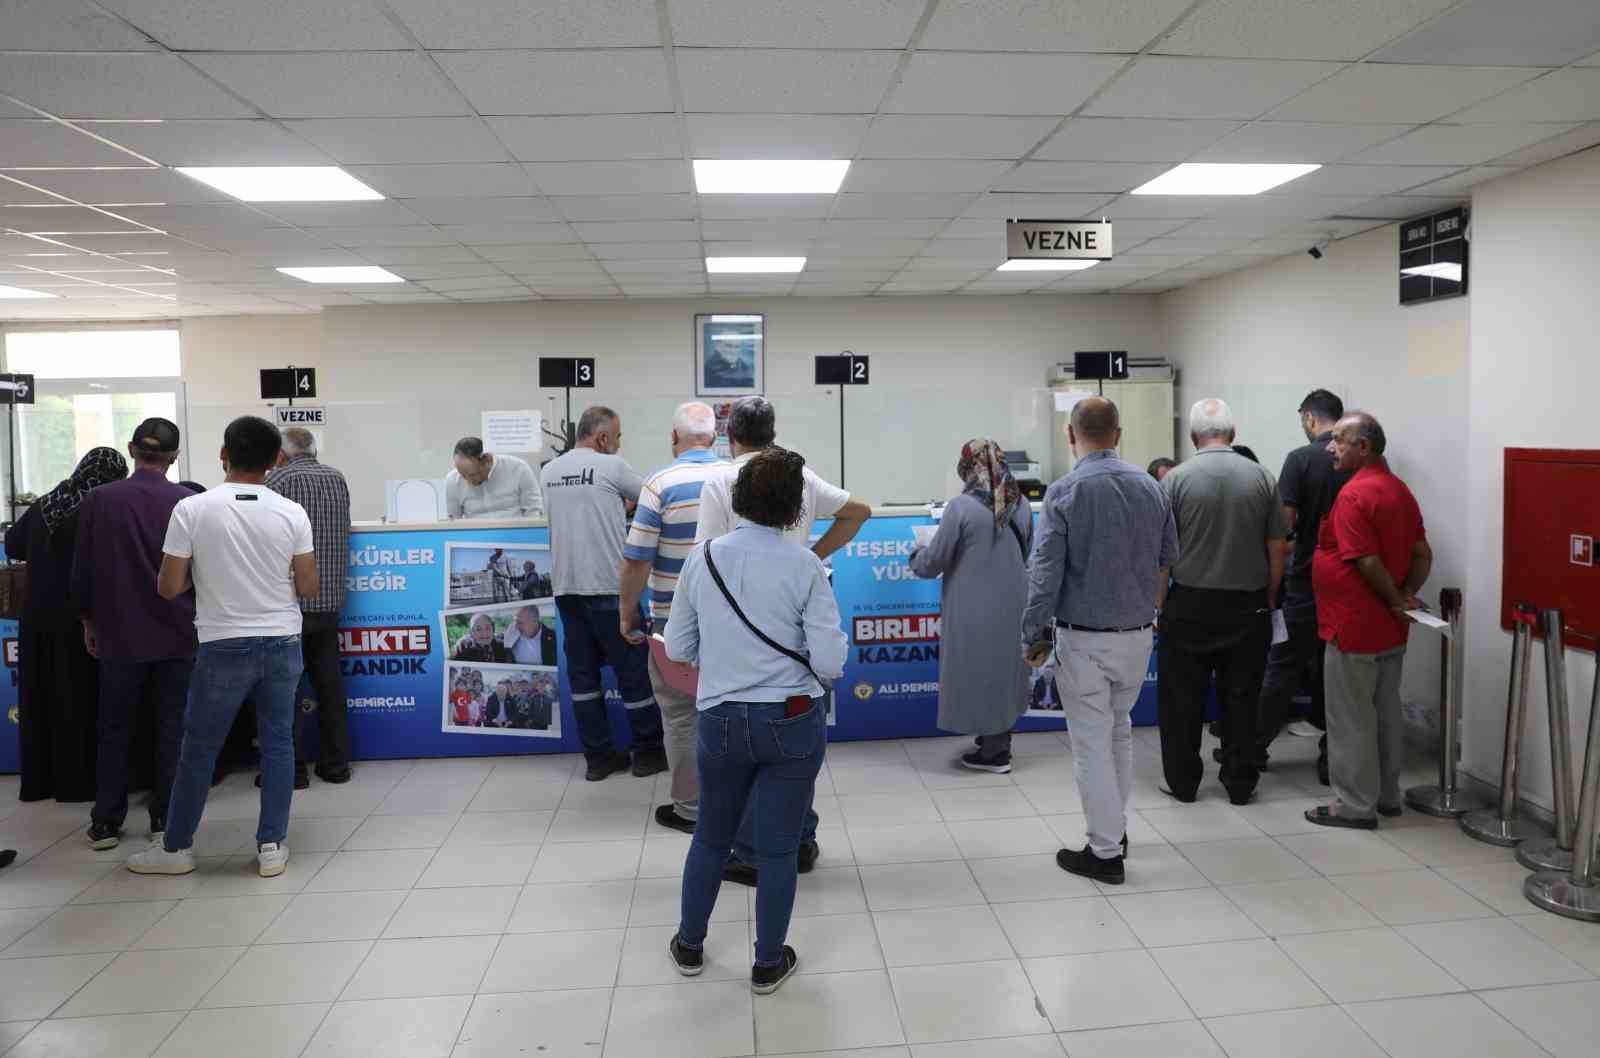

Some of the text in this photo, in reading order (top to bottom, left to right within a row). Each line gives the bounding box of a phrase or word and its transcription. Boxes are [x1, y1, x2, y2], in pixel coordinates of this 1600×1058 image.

[1023, 231, 1097, 250] VEZNE
[580, 365, 591, 381] 3
[855, 362, 865, 378] 2
[1115, 357, 1123, 373] 1
[299, 375, 310, 391] 4
[280, 410, 323, 422] VEZNE
[350, 545, 435, 566] KÜRLER
[846, 540, 914, 559] TEŞEK
[872, 561, 915, 581] YÜR
[345, 571, 407, 591] REĞİR
[856, 617, 941, 640] BİRLİK
[858, 645, 940, 663] KAZAN
[340, 658, 427, 676] ZANDIK
[604, 689, 623, 699] AL
